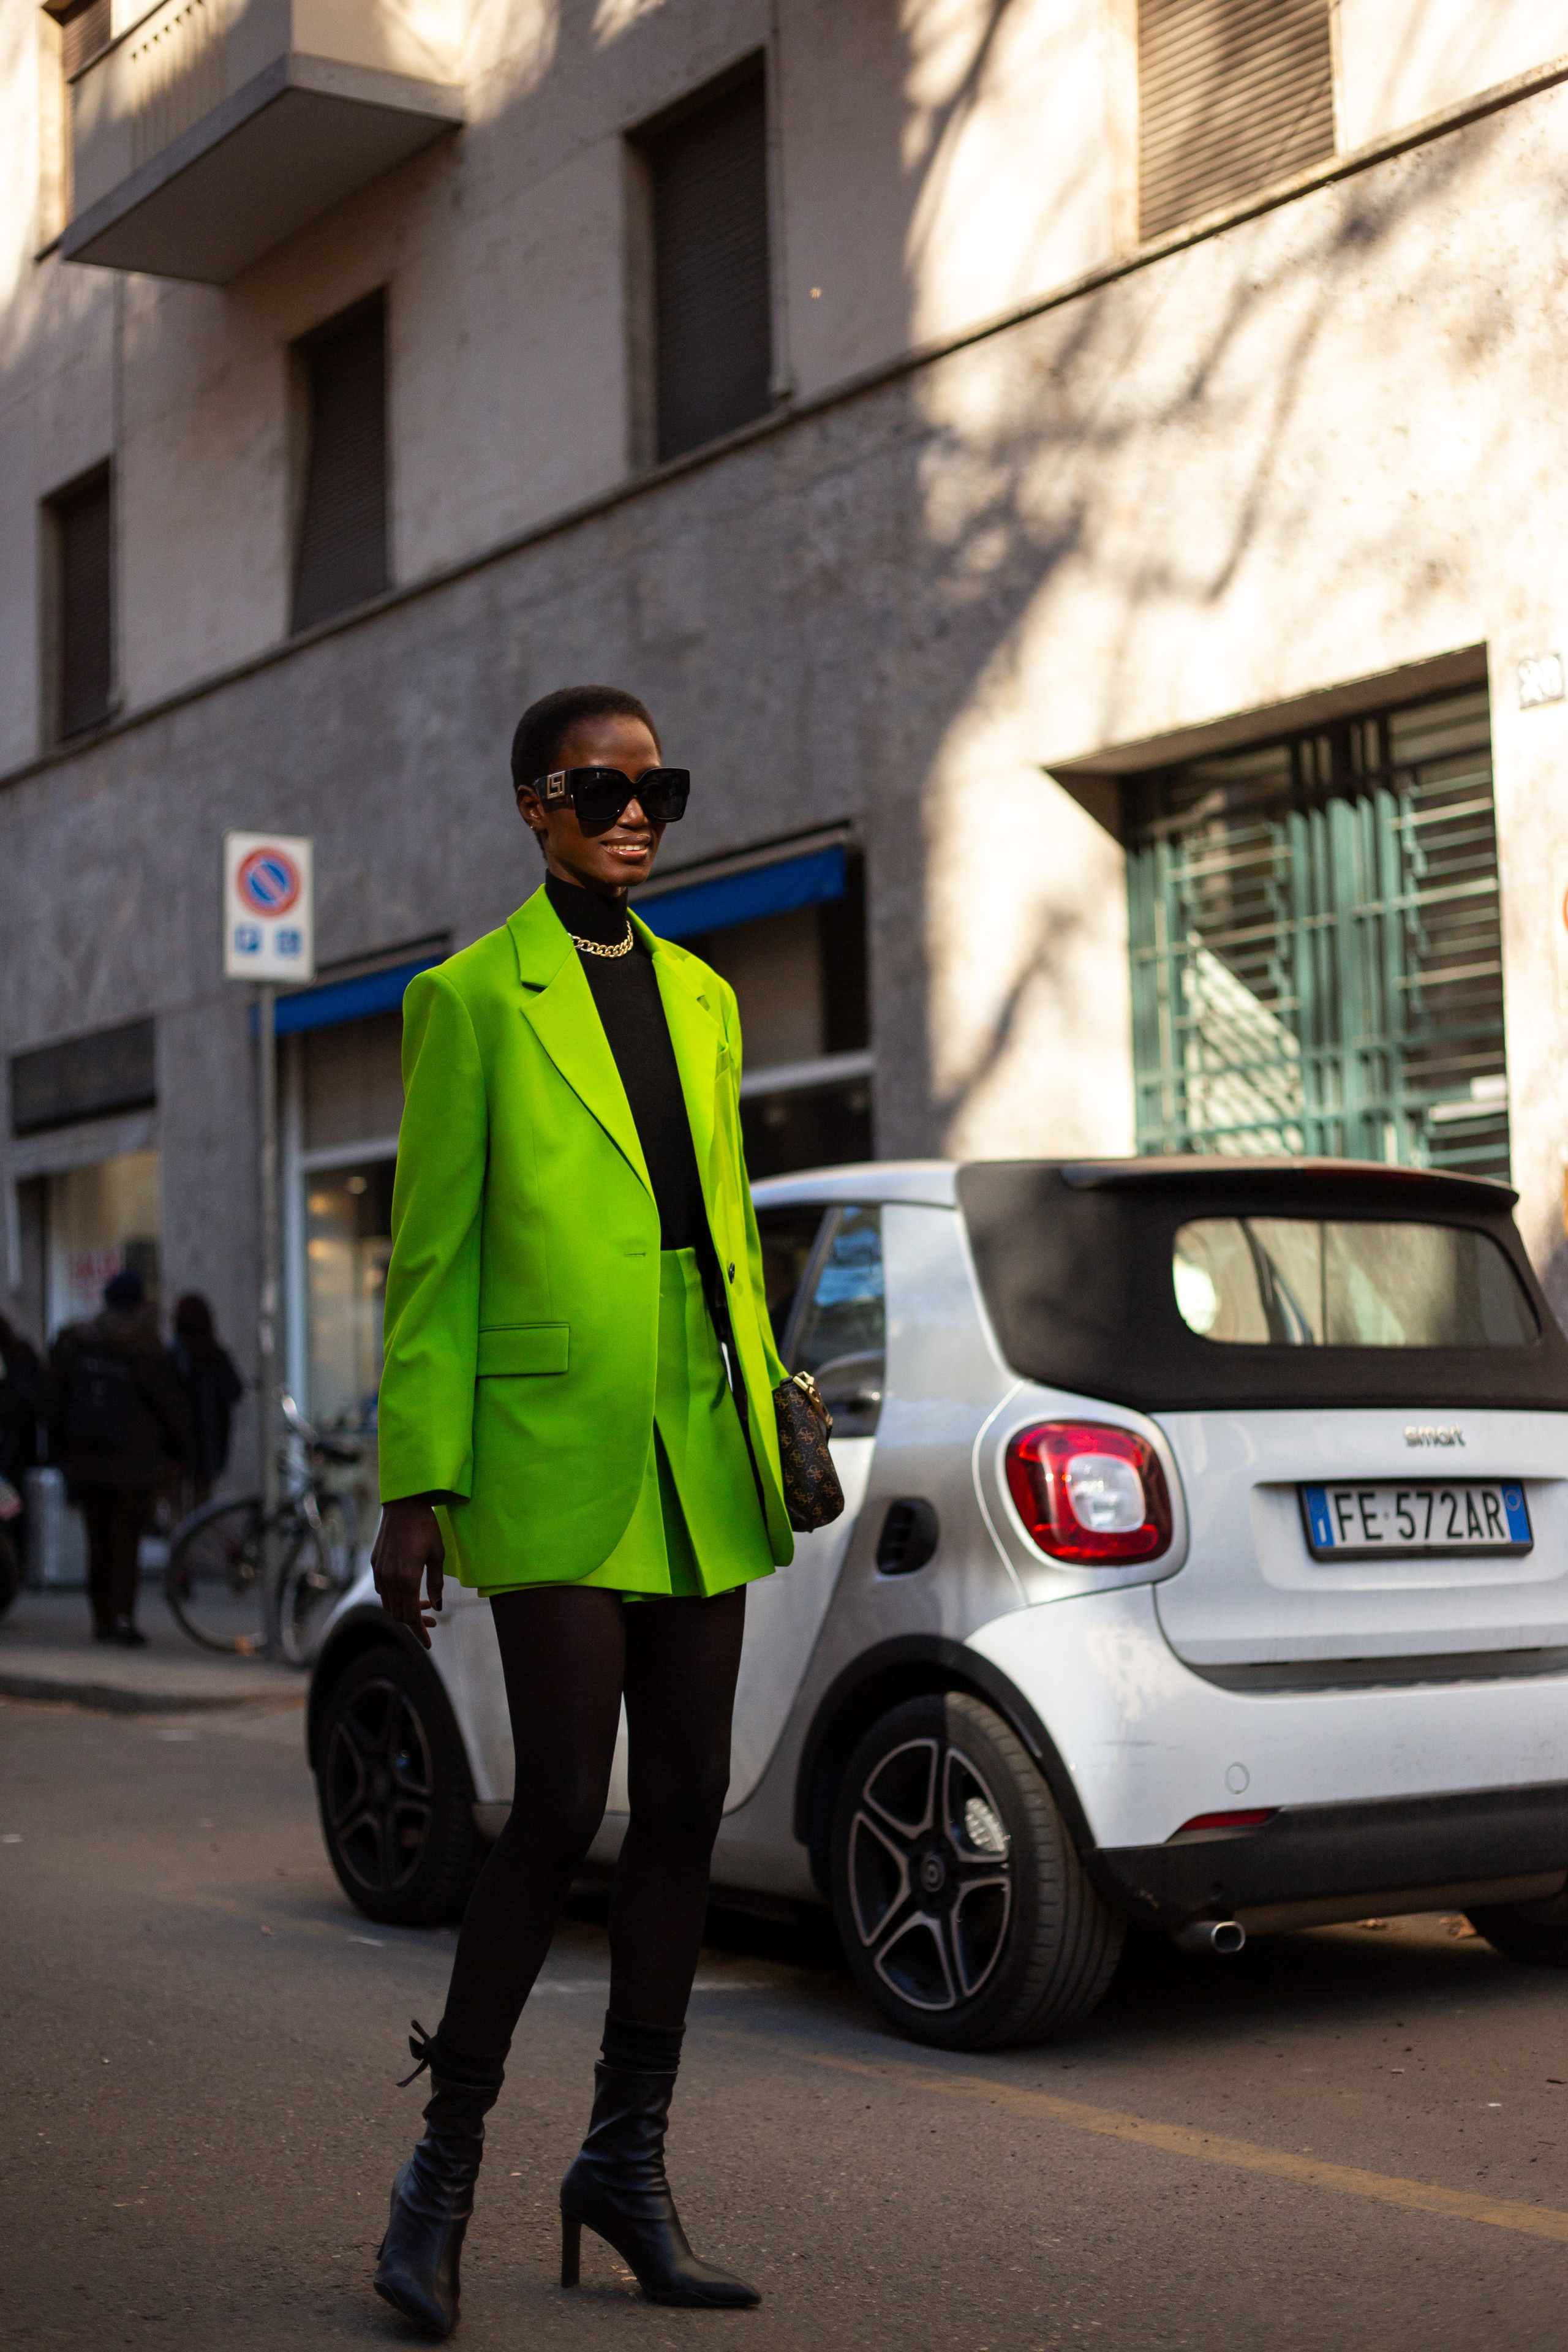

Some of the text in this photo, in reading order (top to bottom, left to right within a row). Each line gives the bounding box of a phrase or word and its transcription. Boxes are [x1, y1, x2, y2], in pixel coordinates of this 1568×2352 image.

[1403, 1423, 1466, 1447] smart
[1333, 1489, 1506, 1542] FE 572AR
